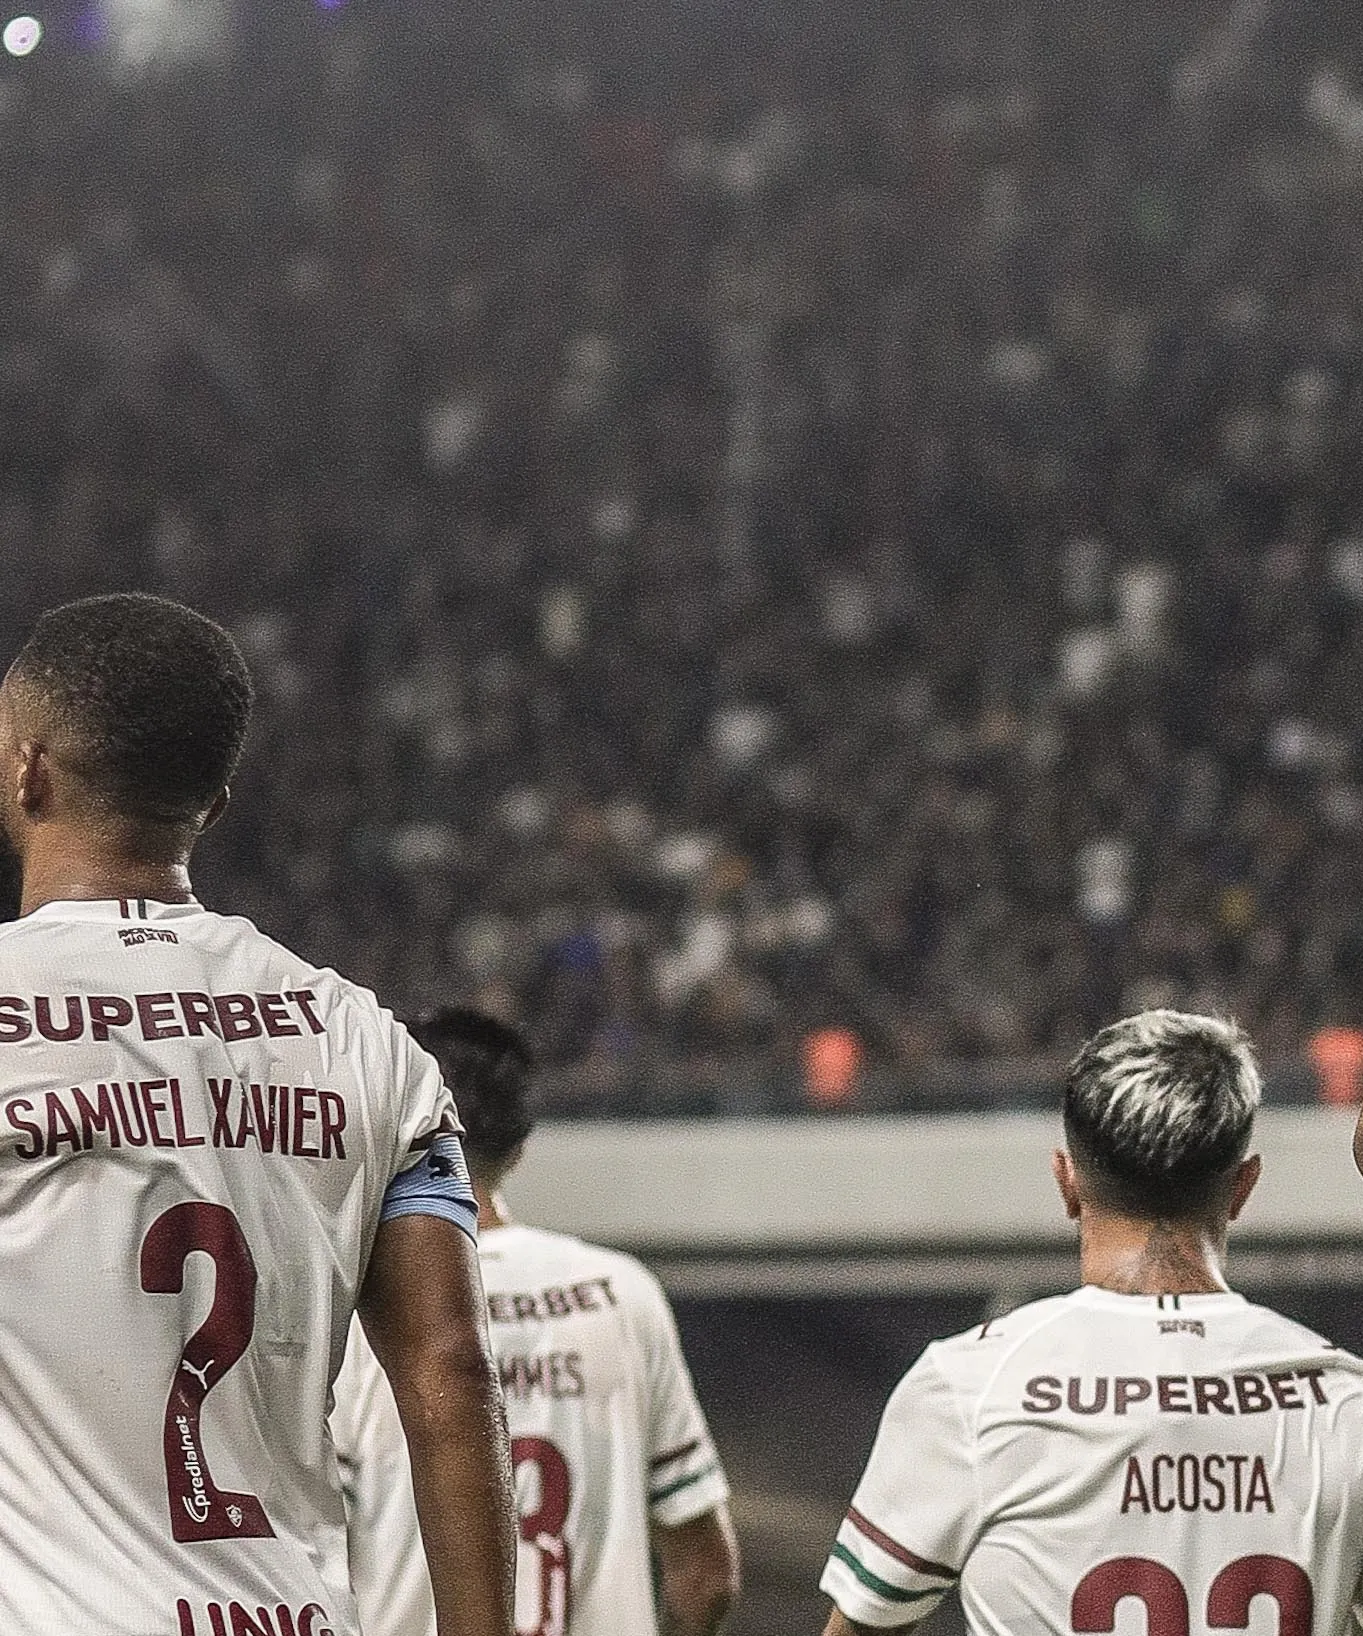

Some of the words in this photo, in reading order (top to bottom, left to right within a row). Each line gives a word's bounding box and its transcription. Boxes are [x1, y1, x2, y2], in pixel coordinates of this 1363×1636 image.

[0, 989, 327, 1043] SUPERBET
[5, 1078, 206, 1160] SAMUEL
[206, 1077, 348, 1160] XAVIER
[487, 1276, 617, 1322] ERBET
[140, 1201, 277, 1544] 2
[1021, 1367, 1329, 1417] SUPERBET
[1120, 1452, 1275, 1515] ACOSTA
